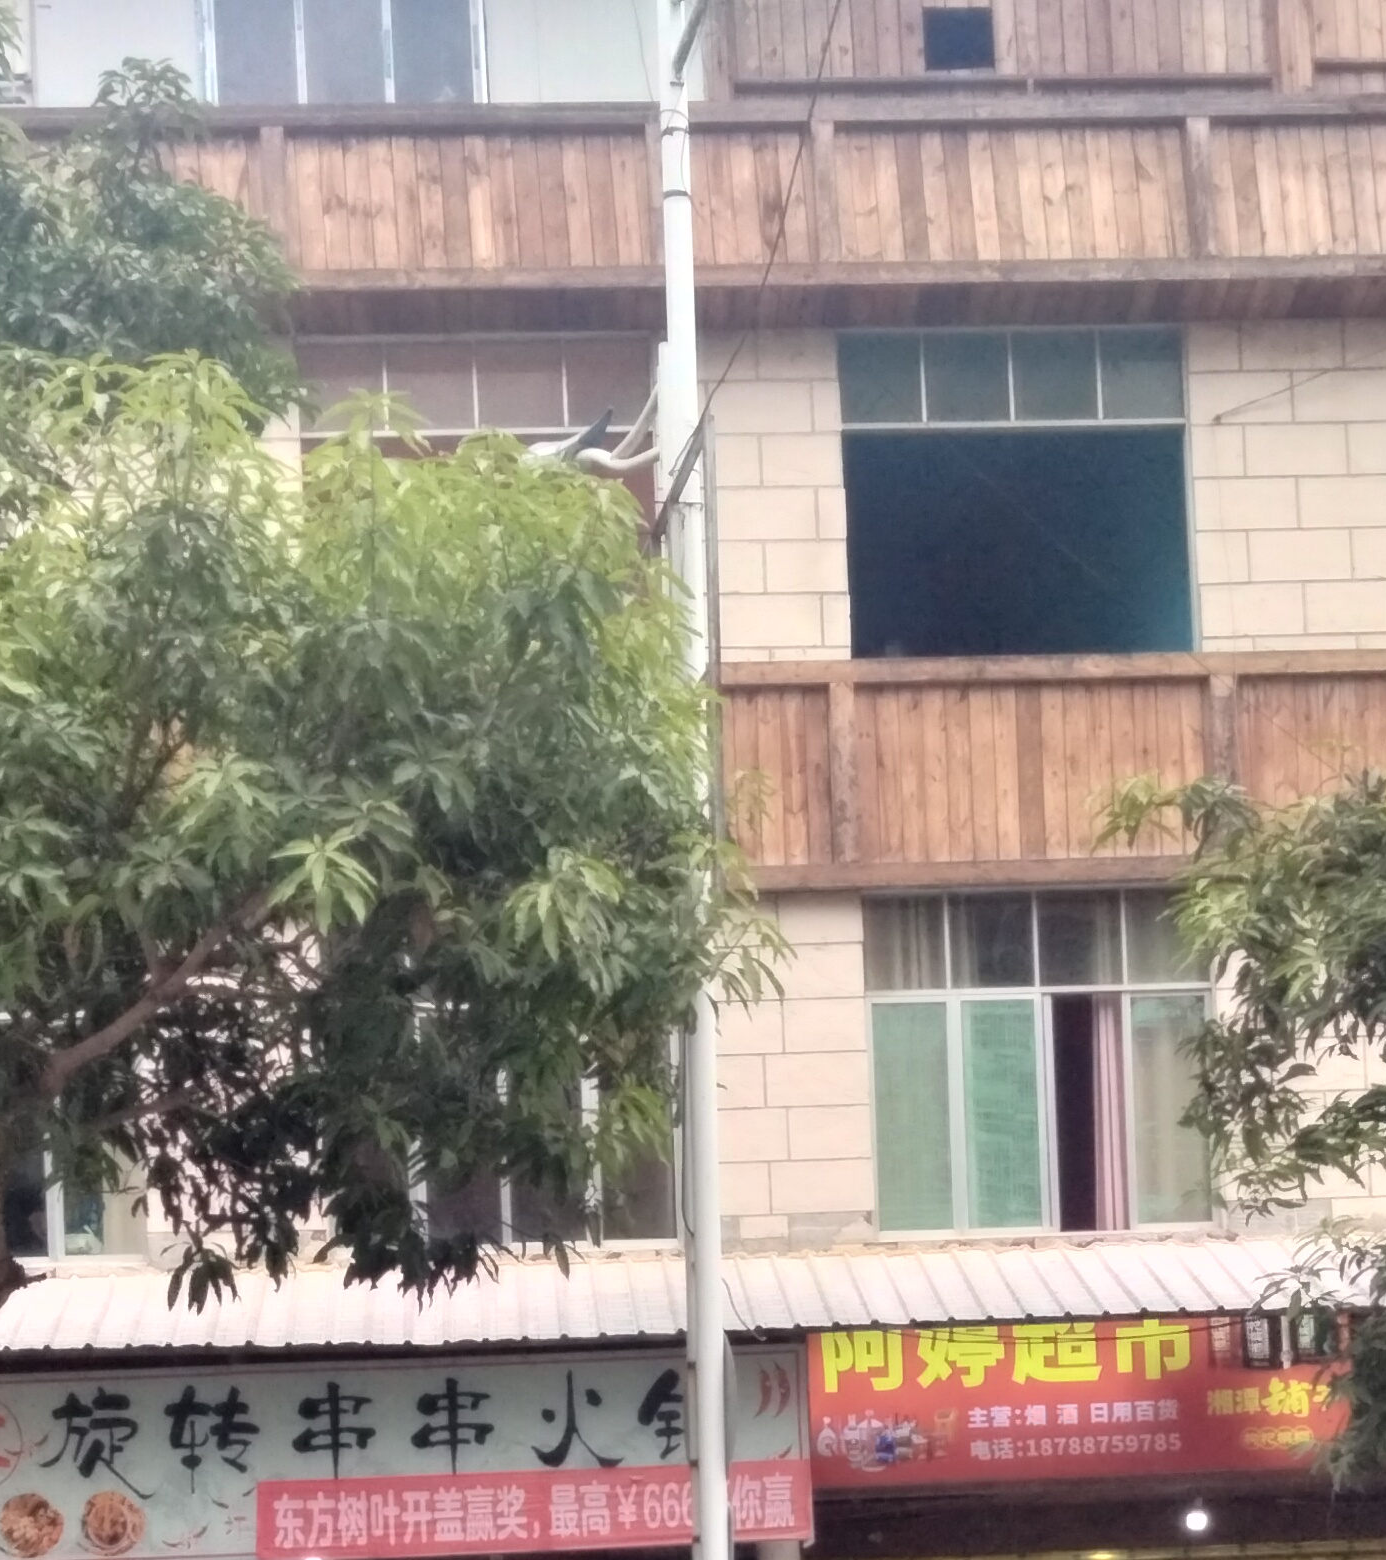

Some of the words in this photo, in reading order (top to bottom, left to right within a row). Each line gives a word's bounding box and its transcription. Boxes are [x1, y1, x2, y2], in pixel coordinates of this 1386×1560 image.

[821, 1319, 1192, 1393] 阿婷超市
[1090, 1399, 1178, 1424] 日用百货
[970, 1433, 1181, 1461] 电话:18788759785
[273, 1471, 795, 1549] 东方树叶开盖赢奖，最高¥666你赢
